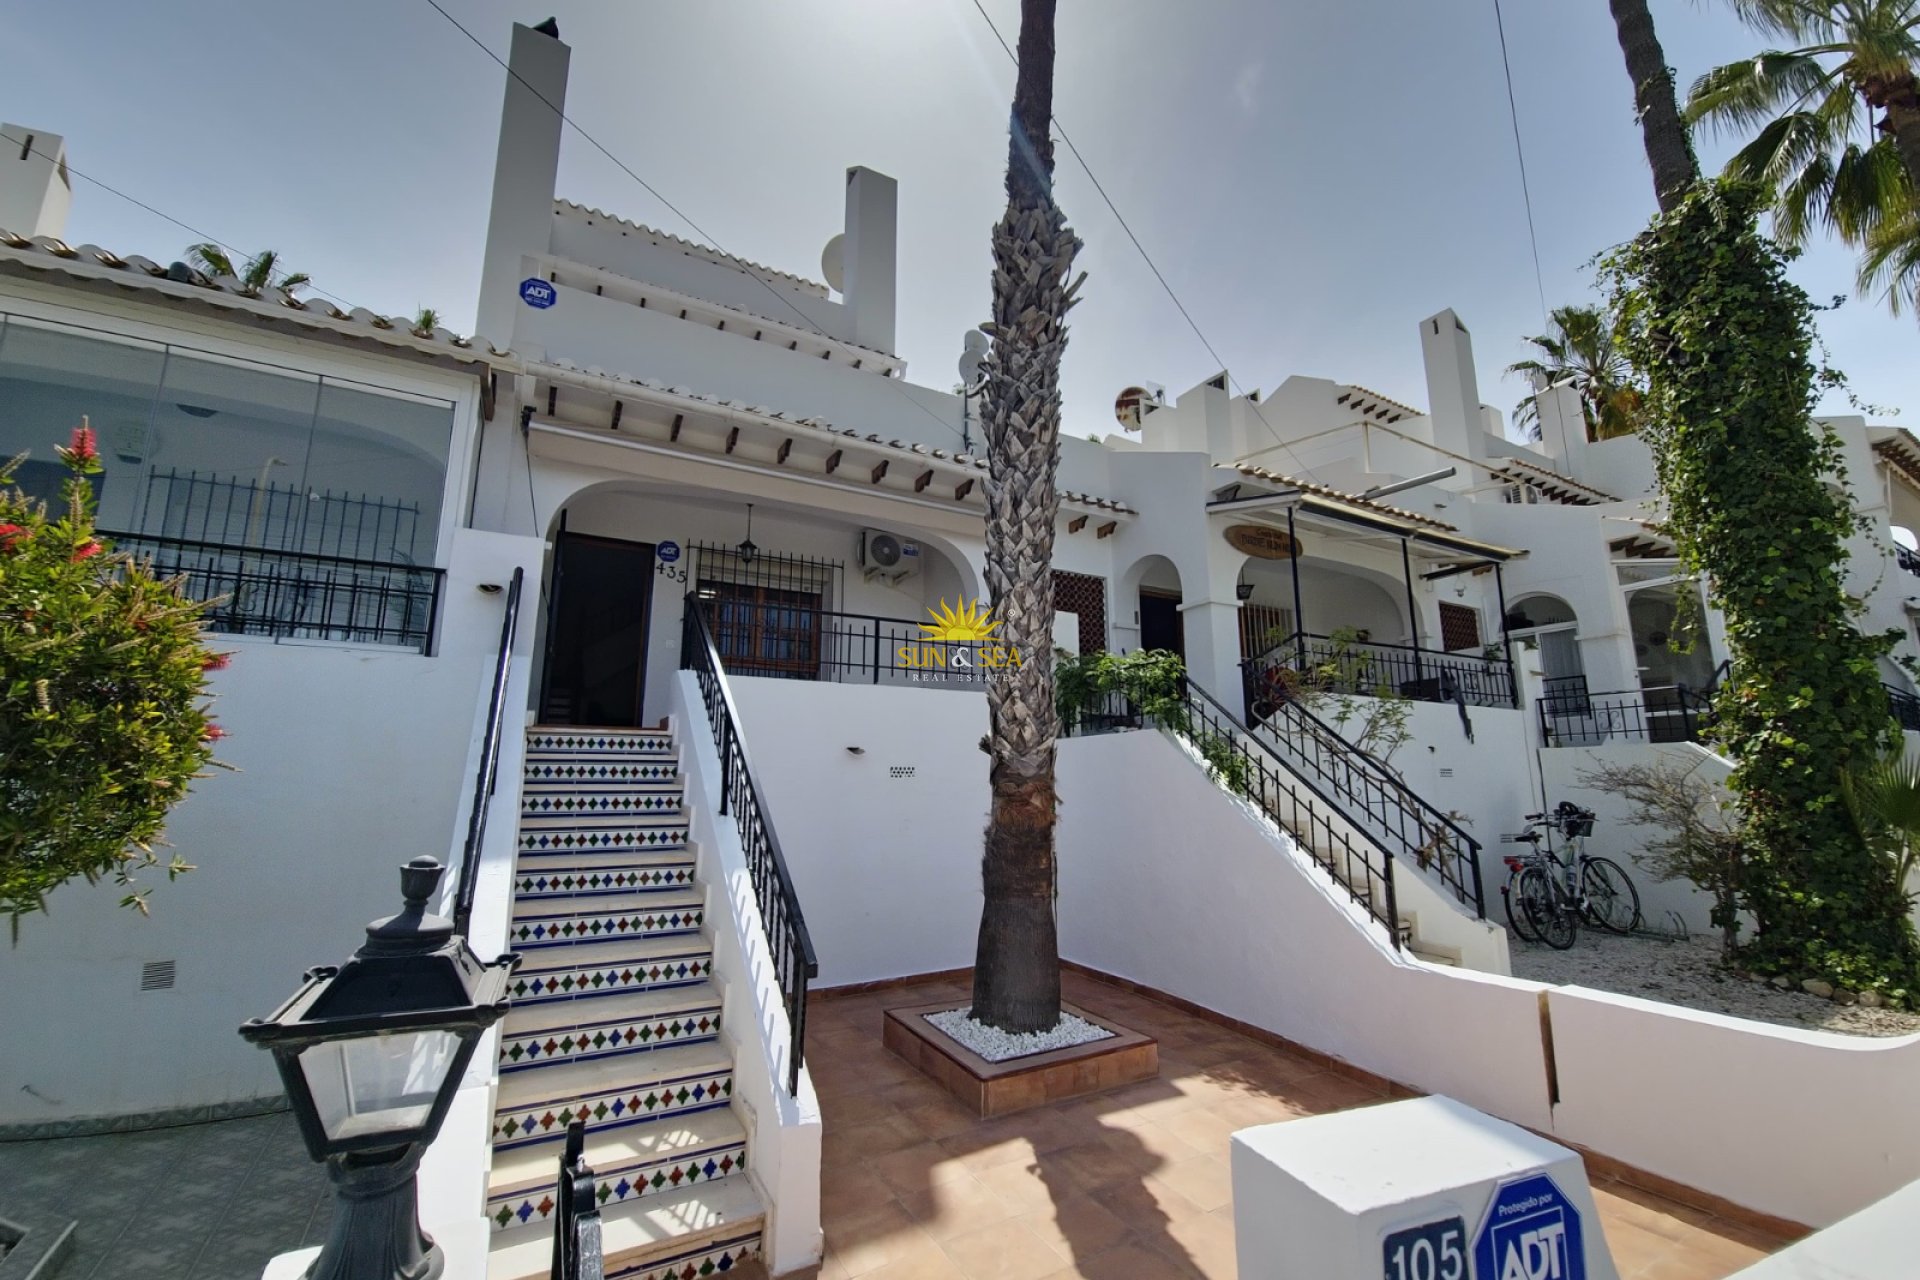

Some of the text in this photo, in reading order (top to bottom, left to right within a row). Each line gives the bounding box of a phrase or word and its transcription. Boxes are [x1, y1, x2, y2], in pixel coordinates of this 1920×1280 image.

[526, 286, 551, 299] ADT
[660, 547, 677, 556] ADT
[656, 562, 687, 583] 435
[1498, 1193, 1553, 1216] Protegido por
[1392, 1229, 1463, 1280] 105
[1500, 1222, 1564, 1280] ADT
